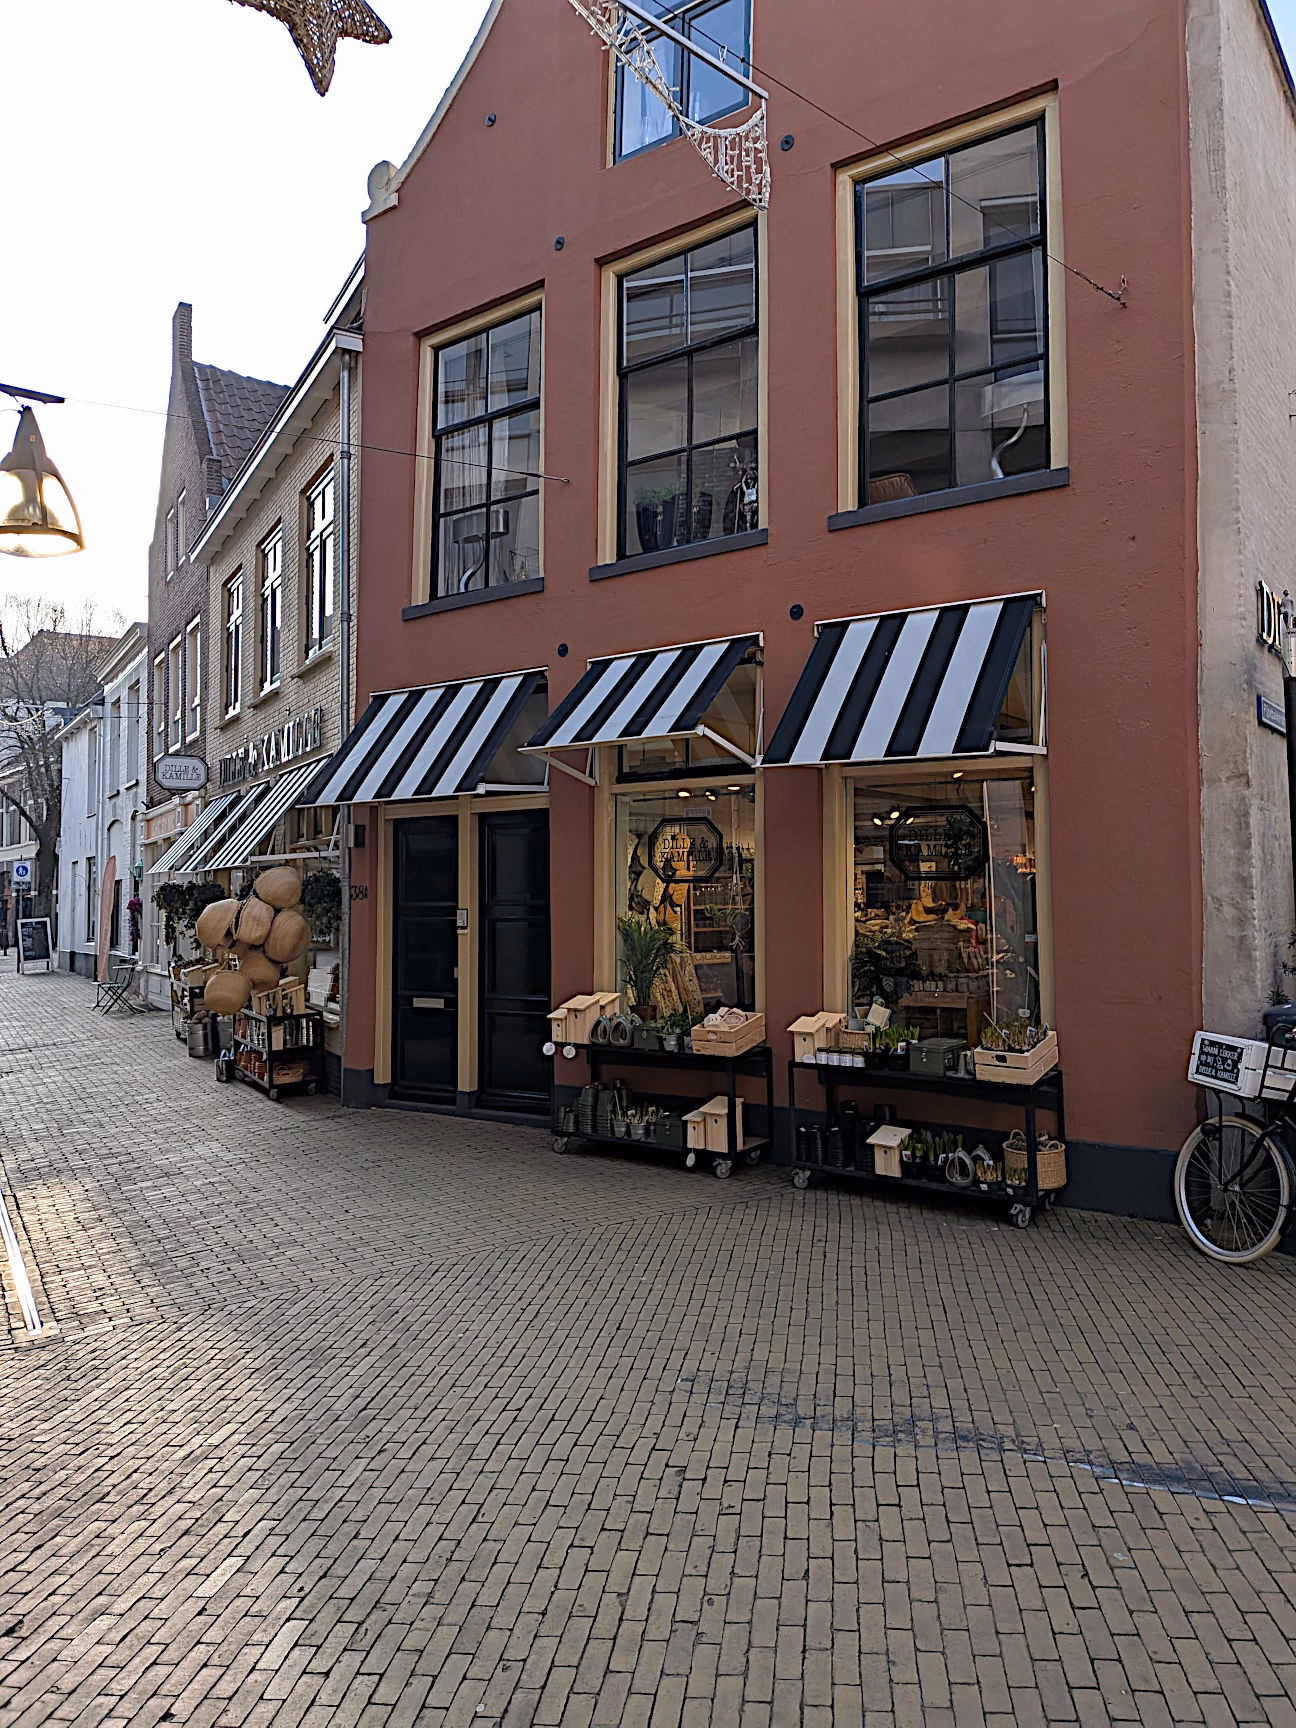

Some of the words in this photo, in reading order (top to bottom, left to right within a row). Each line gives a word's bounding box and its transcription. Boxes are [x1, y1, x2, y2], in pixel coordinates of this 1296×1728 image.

[219, 747, 246, 788] DILLE
[248, 742, 258, 777] &
[259, 706, 321, 772] KAMILLE
[164, 764, 190, 773] DILLE
[192, 765, 199, 774] &
[161, 771, 202, 781] KAMILLE
[662, 837, 696, 850] DILLE
[700, 836, 709, 849] &
[659, 849, 713, 863] KAMILLE
[1200, 1054, 1207, 1064] OP
[1219, 1048, 1239, 1060] LEKKER
[1198, 1065, 1212, 1076] DILLE
[1217, 1069, 1237, 1082] KAMILLE
